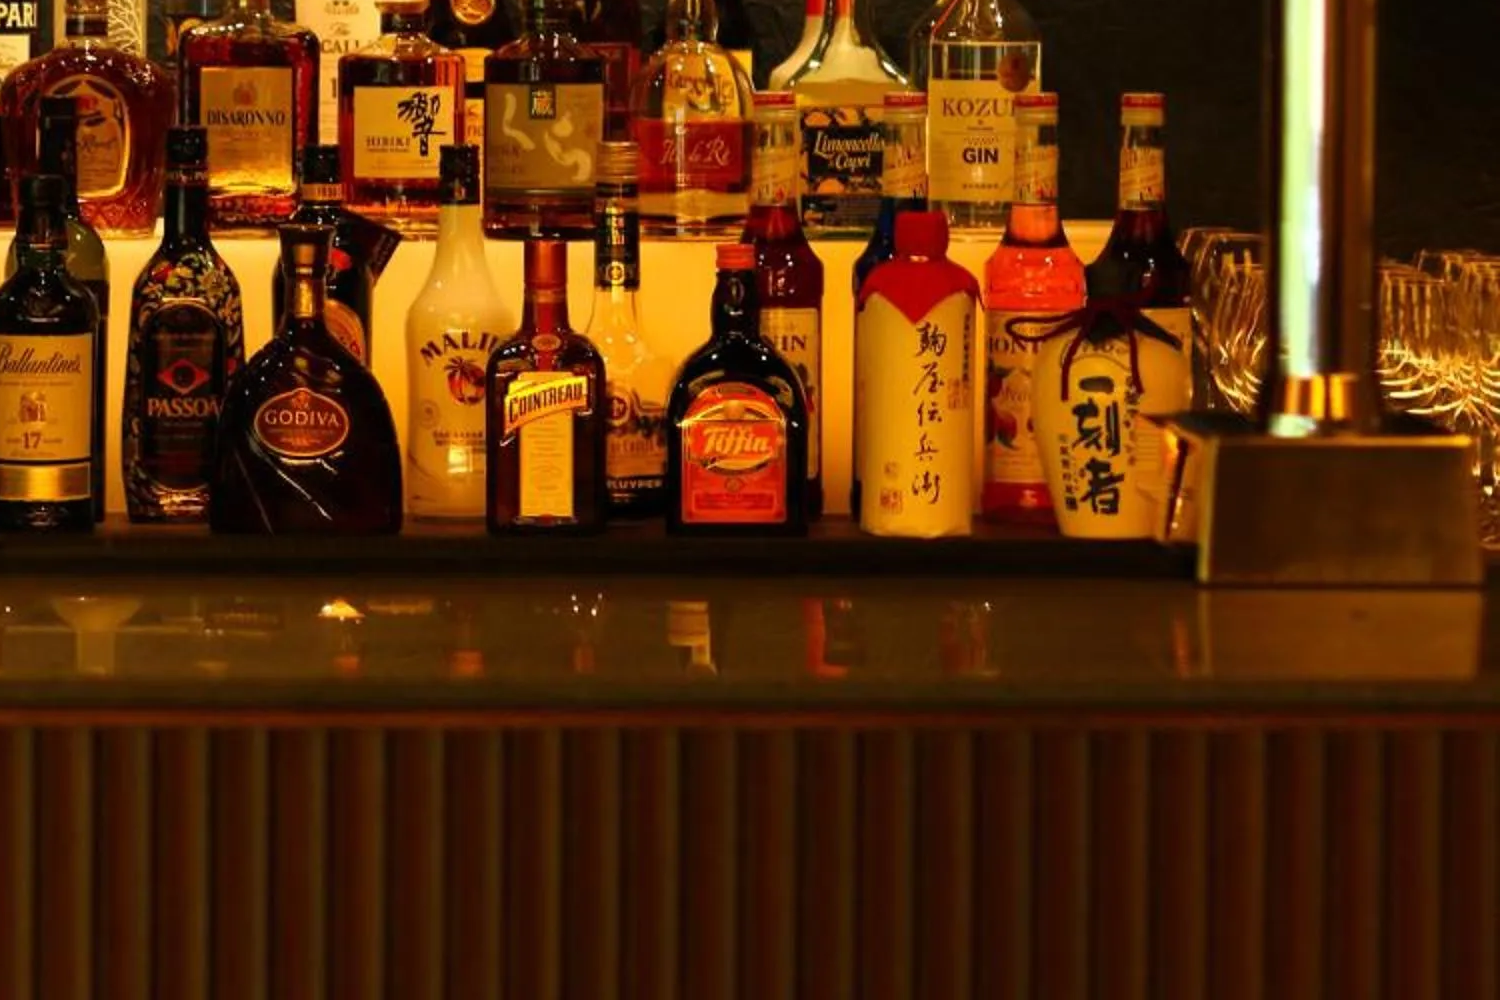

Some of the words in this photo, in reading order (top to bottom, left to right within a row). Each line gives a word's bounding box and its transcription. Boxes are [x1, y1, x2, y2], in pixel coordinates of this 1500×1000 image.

[207, 111, 286, 127] DISARONNO
[962, 148, 999, 164] GIN
[508, 383, 583, 424] COINTREAU
[264, 410, 340, 428] GODIVA
[21, 431, 42, 450] 17
[703, 427, 771, 455] Tiffin
[1072, 377, 1125, 514] 一刻者
